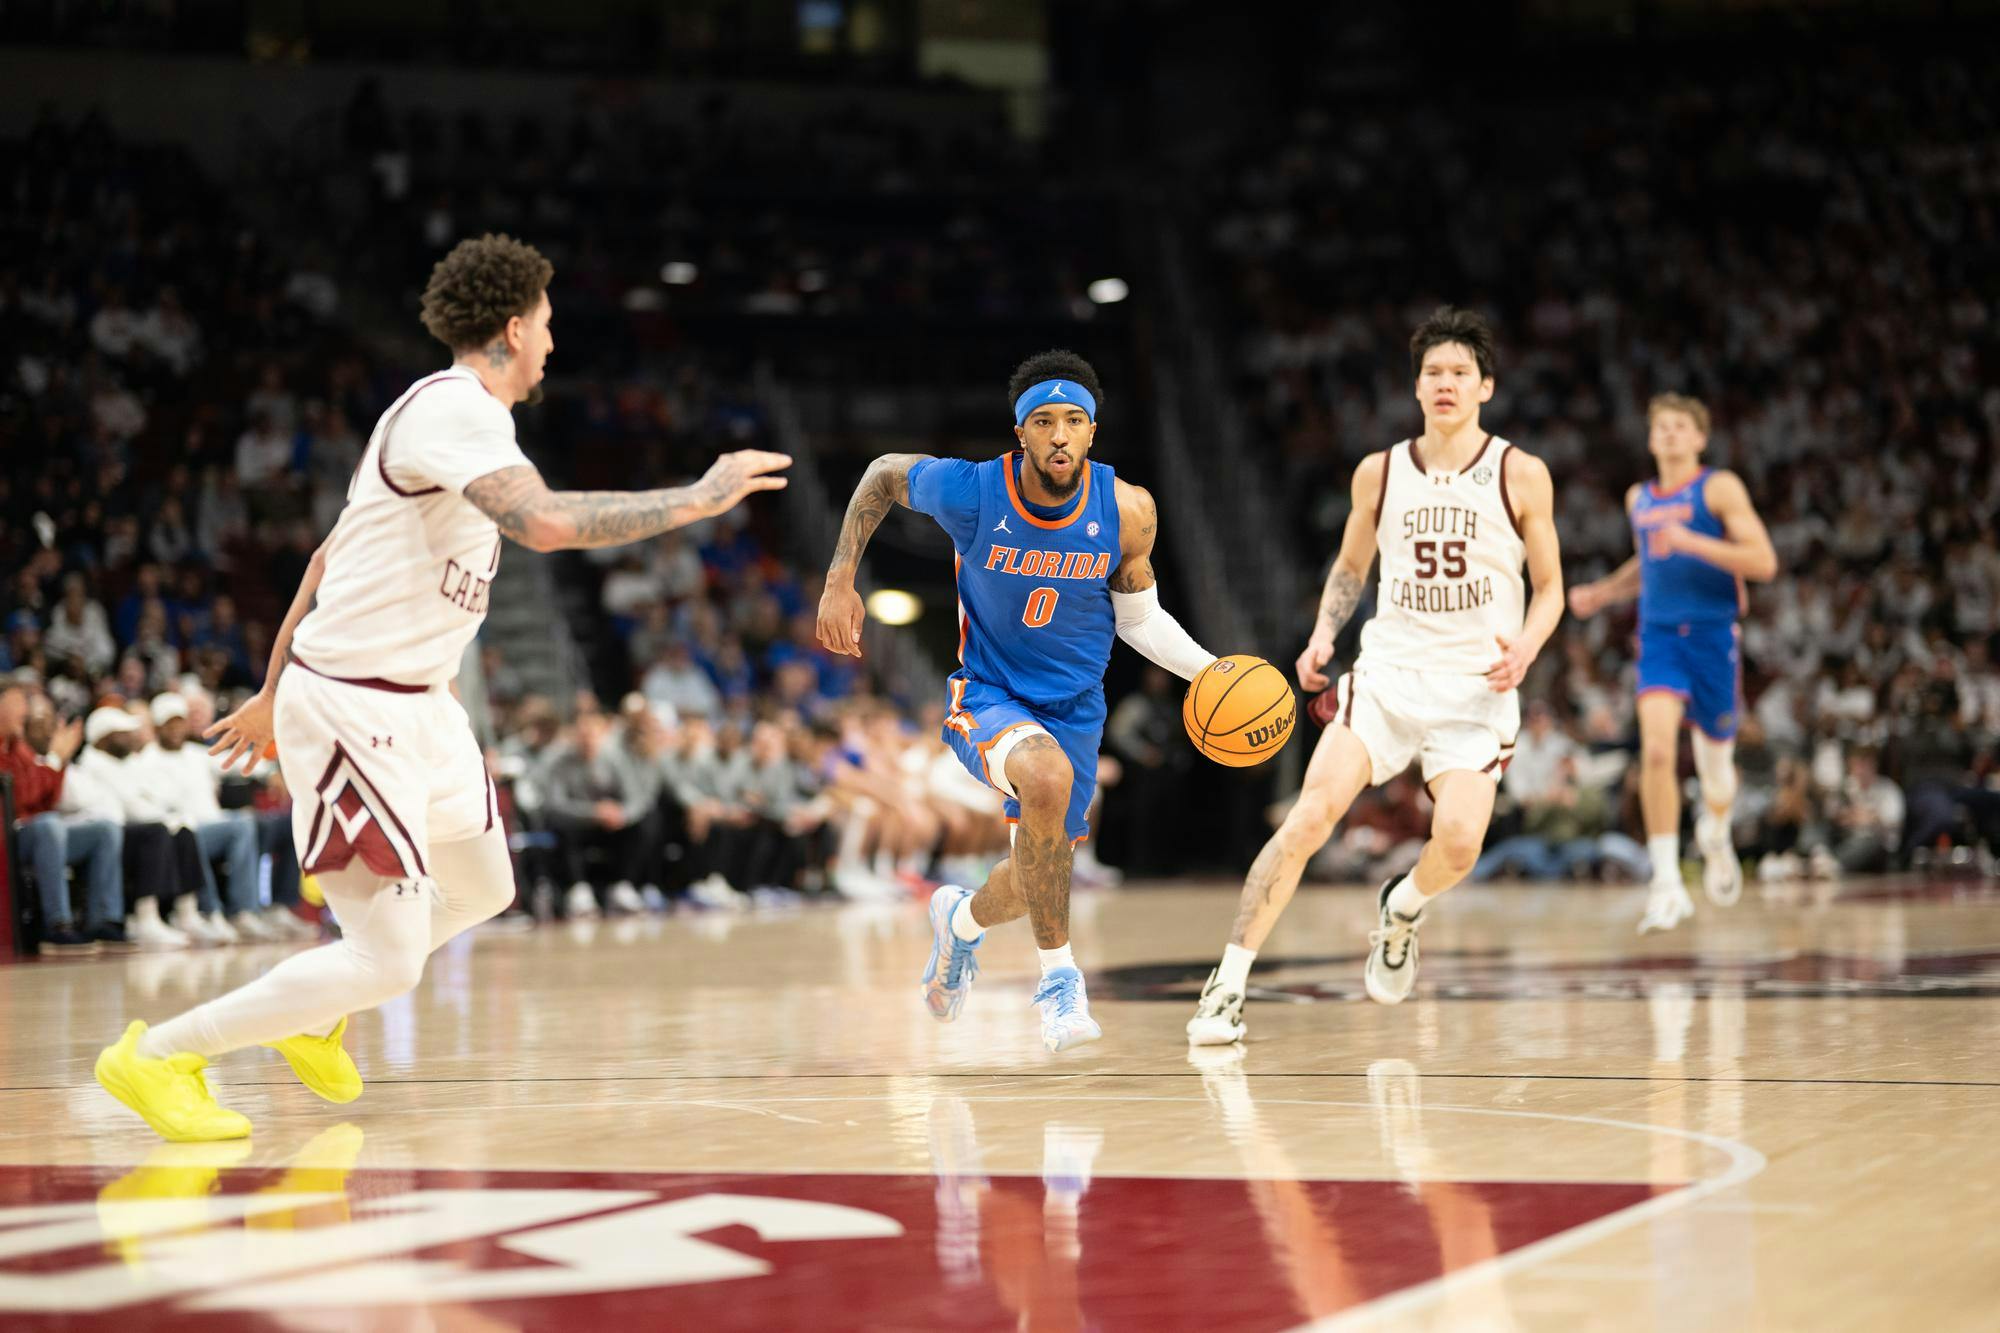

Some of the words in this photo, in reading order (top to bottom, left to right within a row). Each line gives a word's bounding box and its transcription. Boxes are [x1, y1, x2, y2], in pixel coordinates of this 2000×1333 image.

[1404, 506, 1477, 539] SOUTH
[984, 544, 1111, 579] FLORIDA
[1414, 541, 1467, 579] 55
[1022, 587, 1060, 628] 0
[1390, 576, 1493, 612] CAROLINA
